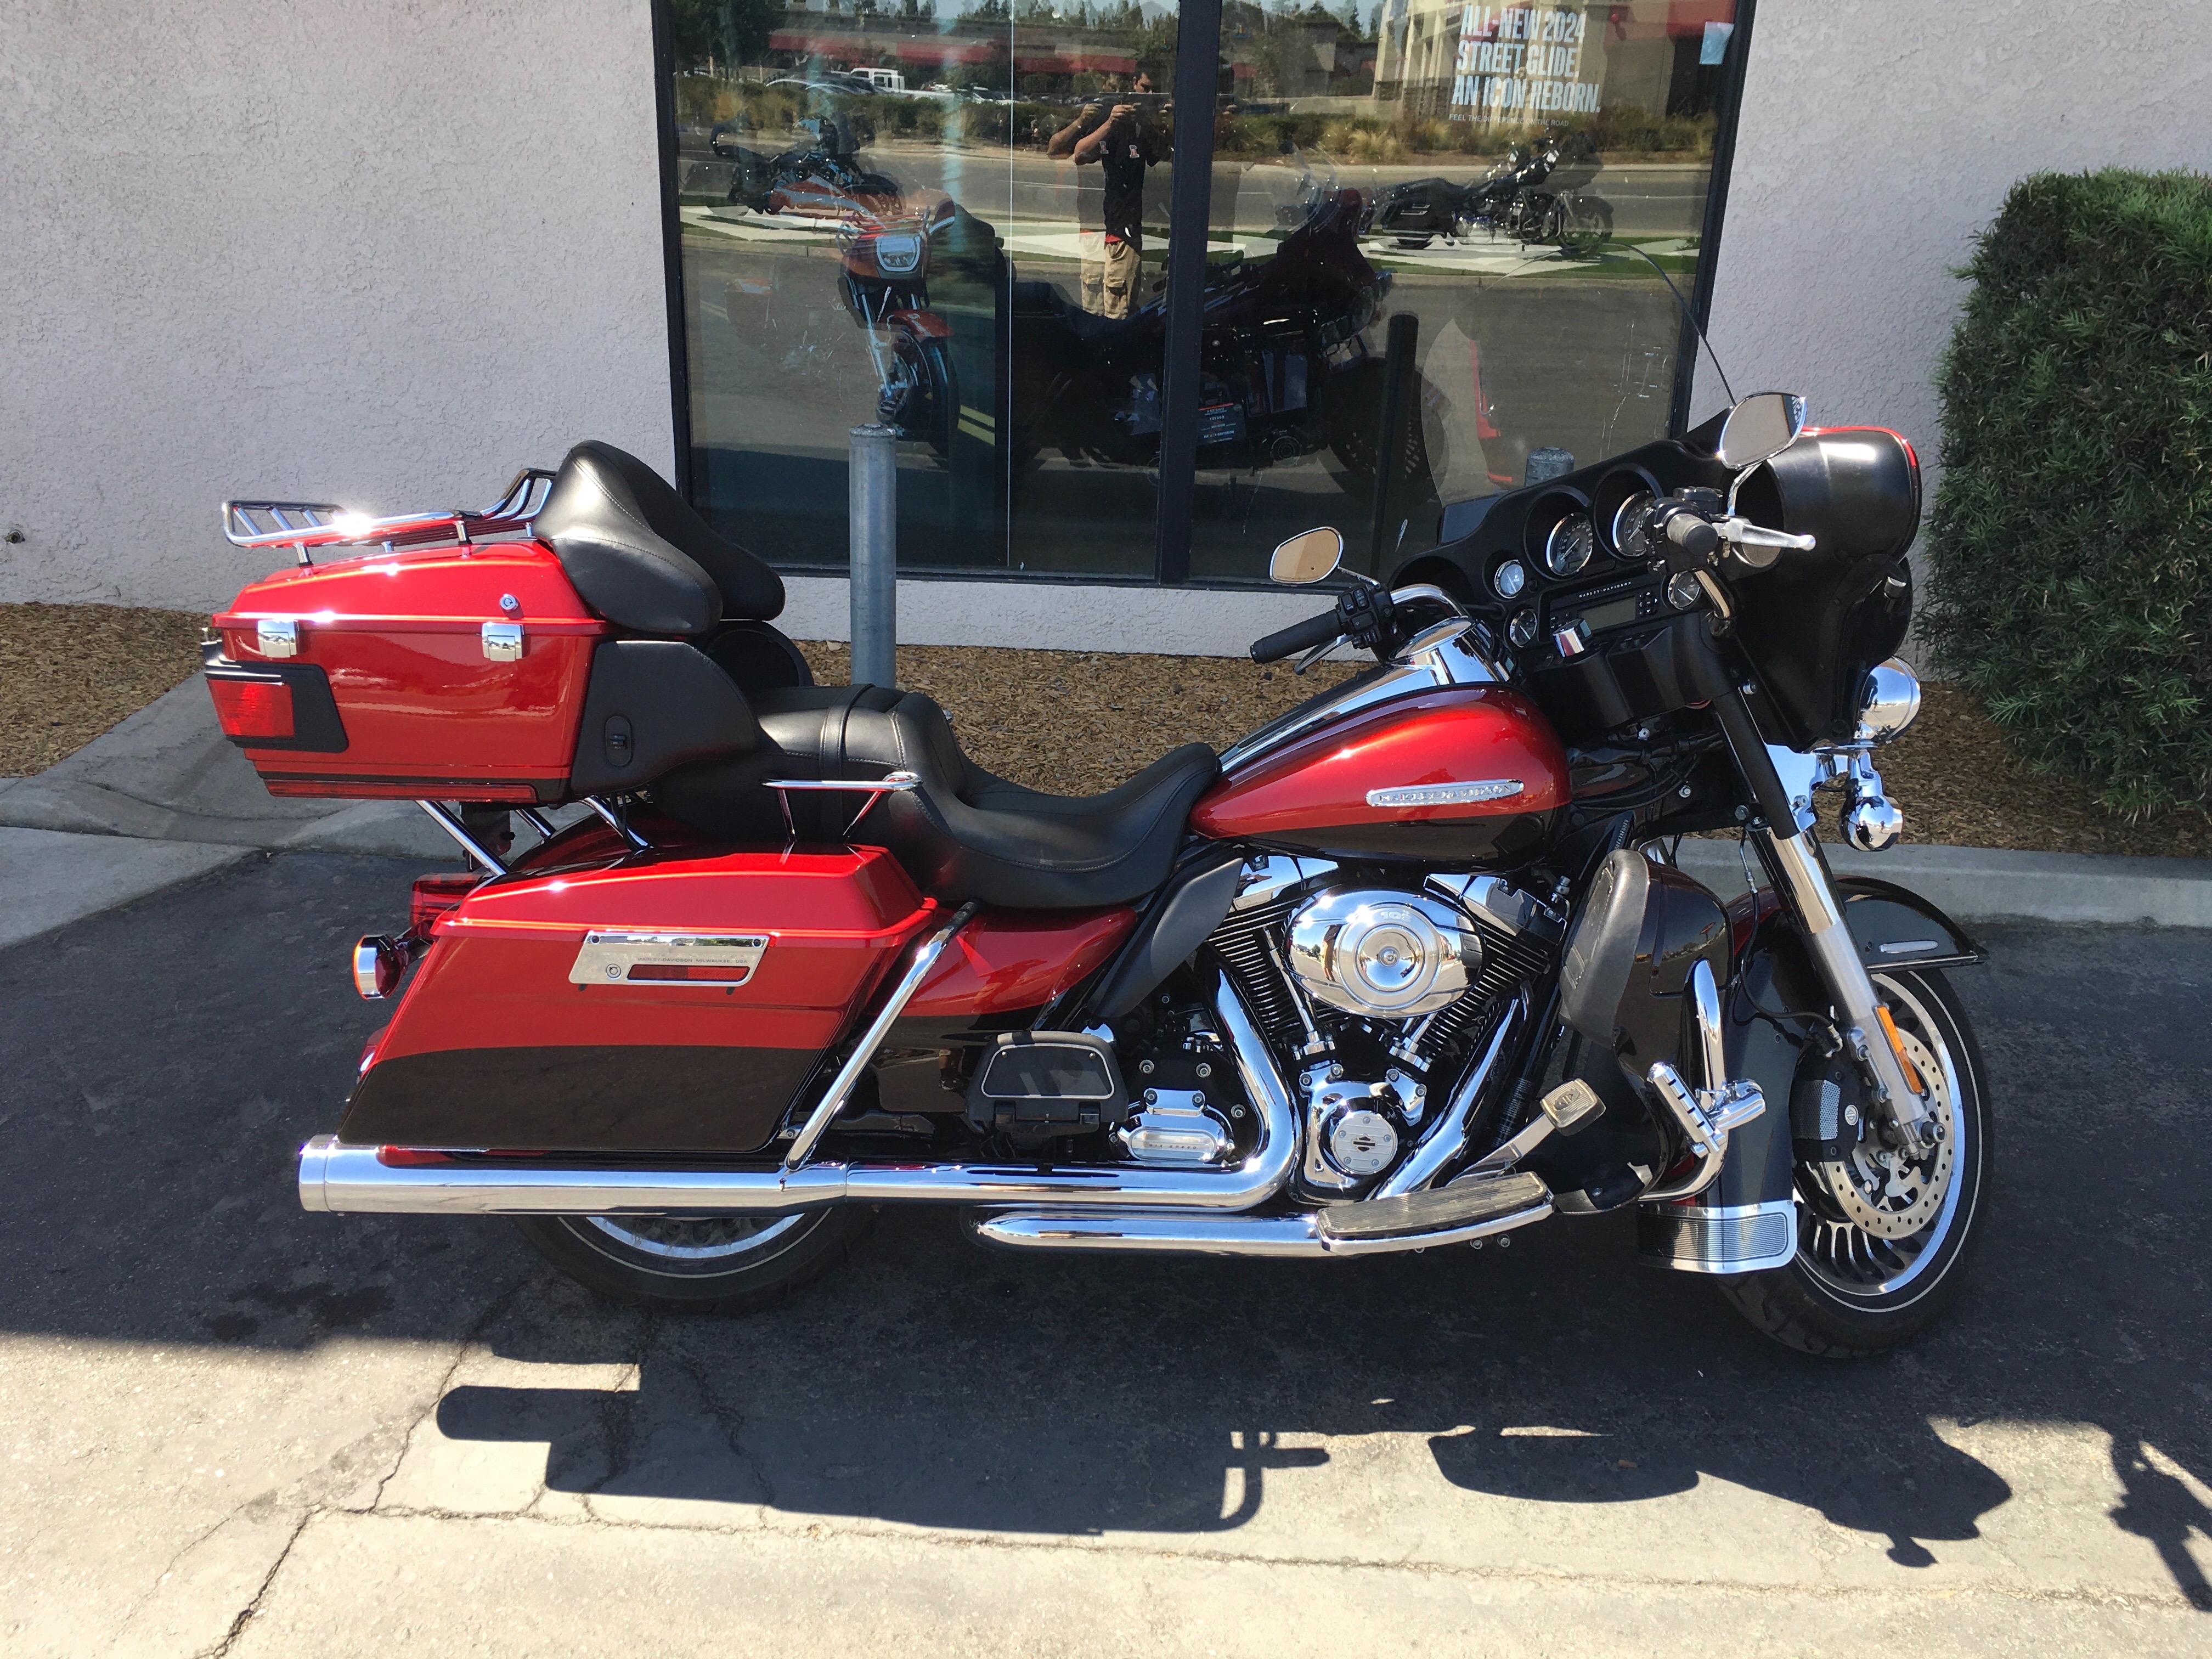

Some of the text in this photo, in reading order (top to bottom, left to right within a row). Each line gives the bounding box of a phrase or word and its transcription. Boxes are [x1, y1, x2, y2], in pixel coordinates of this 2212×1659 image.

[1460, 4, 1587, 43] ALL-NEW 2024
[1456, 40, 1579, 78] STREET GLIDE.
[1451, 75, 1601, 113] AN ICON REBORN.
